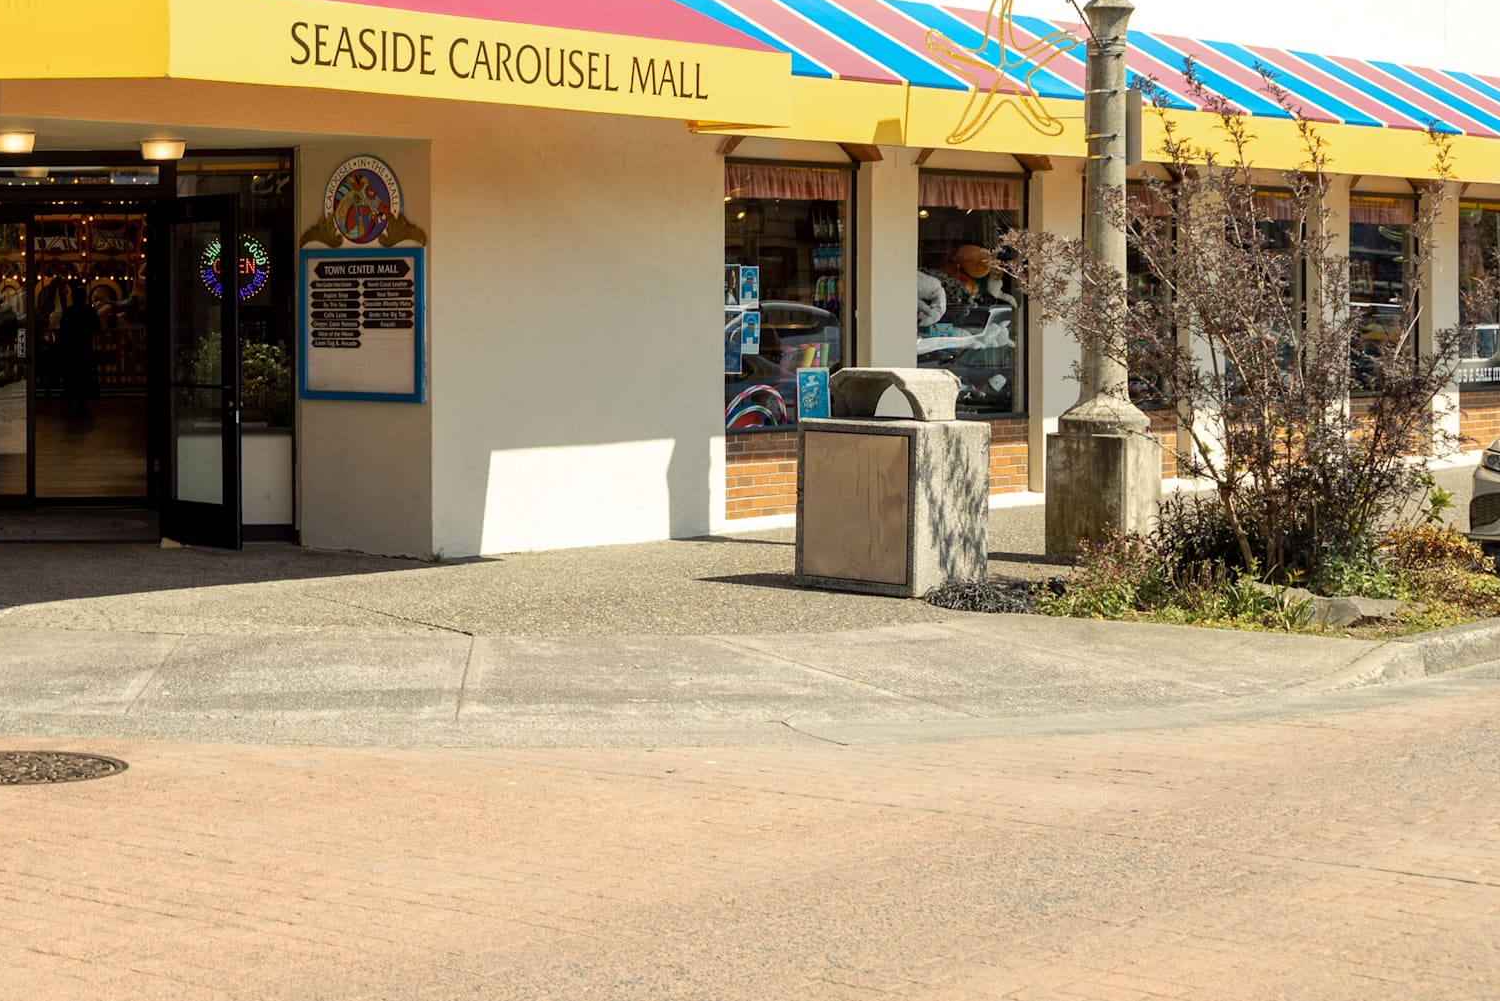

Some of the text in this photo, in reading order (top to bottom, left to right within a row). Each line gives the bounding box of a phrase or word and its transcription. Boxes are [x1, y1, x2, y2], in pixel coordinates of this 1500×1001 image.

[291, 21, 708, 99] SEASIDE CAROUSEL MALL
[326, 159, 399, 209] CAROUSEL IN THE MALL
[213, 258, 255, 274] OEN
[324, 264, 398, 275] TOWN CENTER MALL
[1475, 368, 1492, 382] SALE
